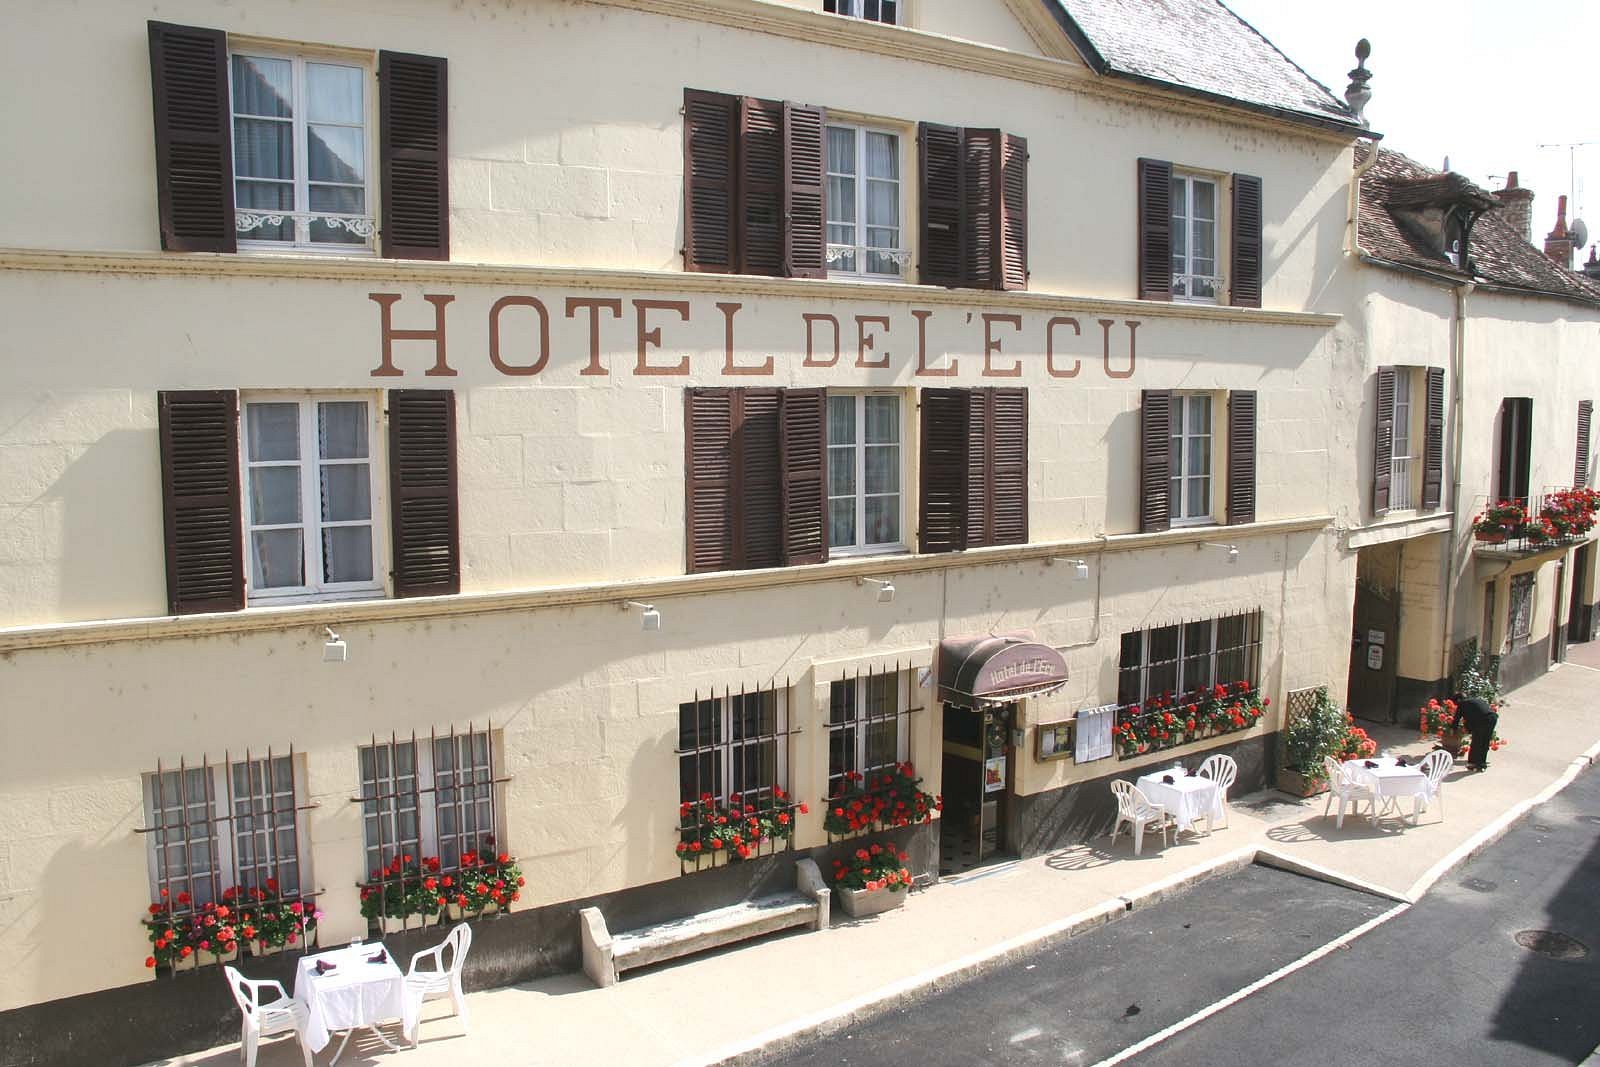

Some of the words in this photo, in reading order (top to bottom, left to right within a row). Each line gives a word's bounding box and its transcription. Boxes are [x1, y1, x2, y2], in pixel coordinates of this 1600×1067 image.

[368, 293, 774, 377] HOTEL
[802, 313, 890, 368] DE
[911, 310, 1142, 379] L'ECU
